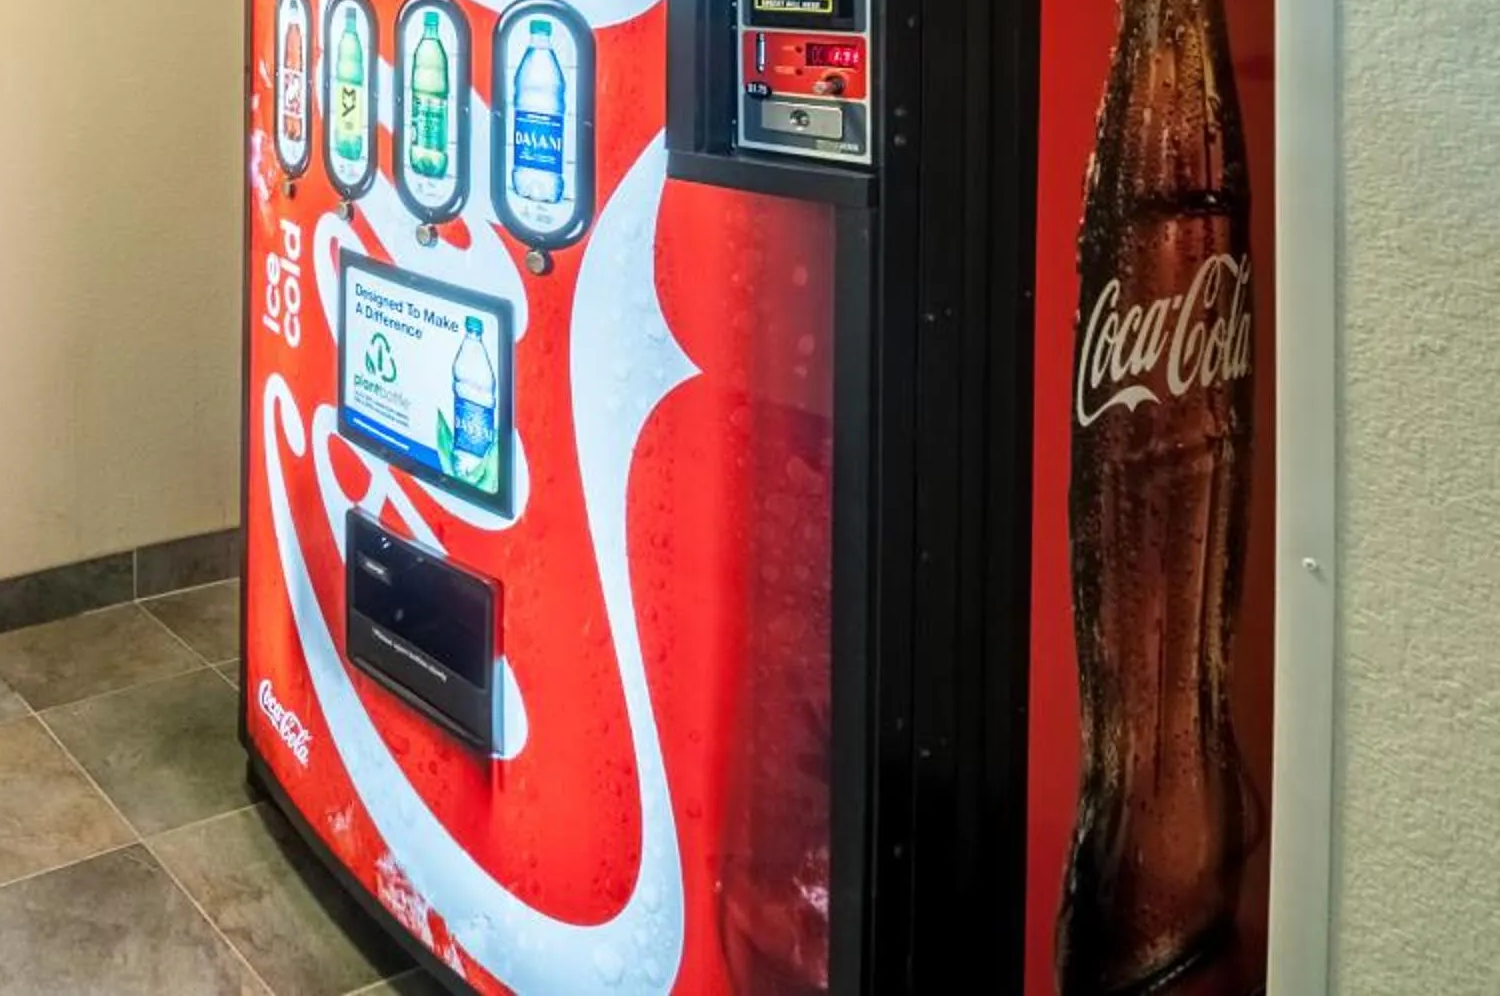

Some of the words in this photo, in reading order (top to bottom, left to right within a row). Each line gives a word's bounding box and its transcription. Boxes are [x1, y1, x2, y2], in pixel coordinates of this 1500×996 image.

[515, 131, 562, 152] DASANI
[280, 219, 301, 348] cold
[355, 283, 403, 313] Designed
[407, 303, 421, 319] To
[423, 308, 459, 332] Make
[355, 301, 363, 313] A
[365, 305, 423, 339] Difference
[1077, 253, 1251, 427] Coca-Cola
[259, 679, 313, 767] Coca-Cola
